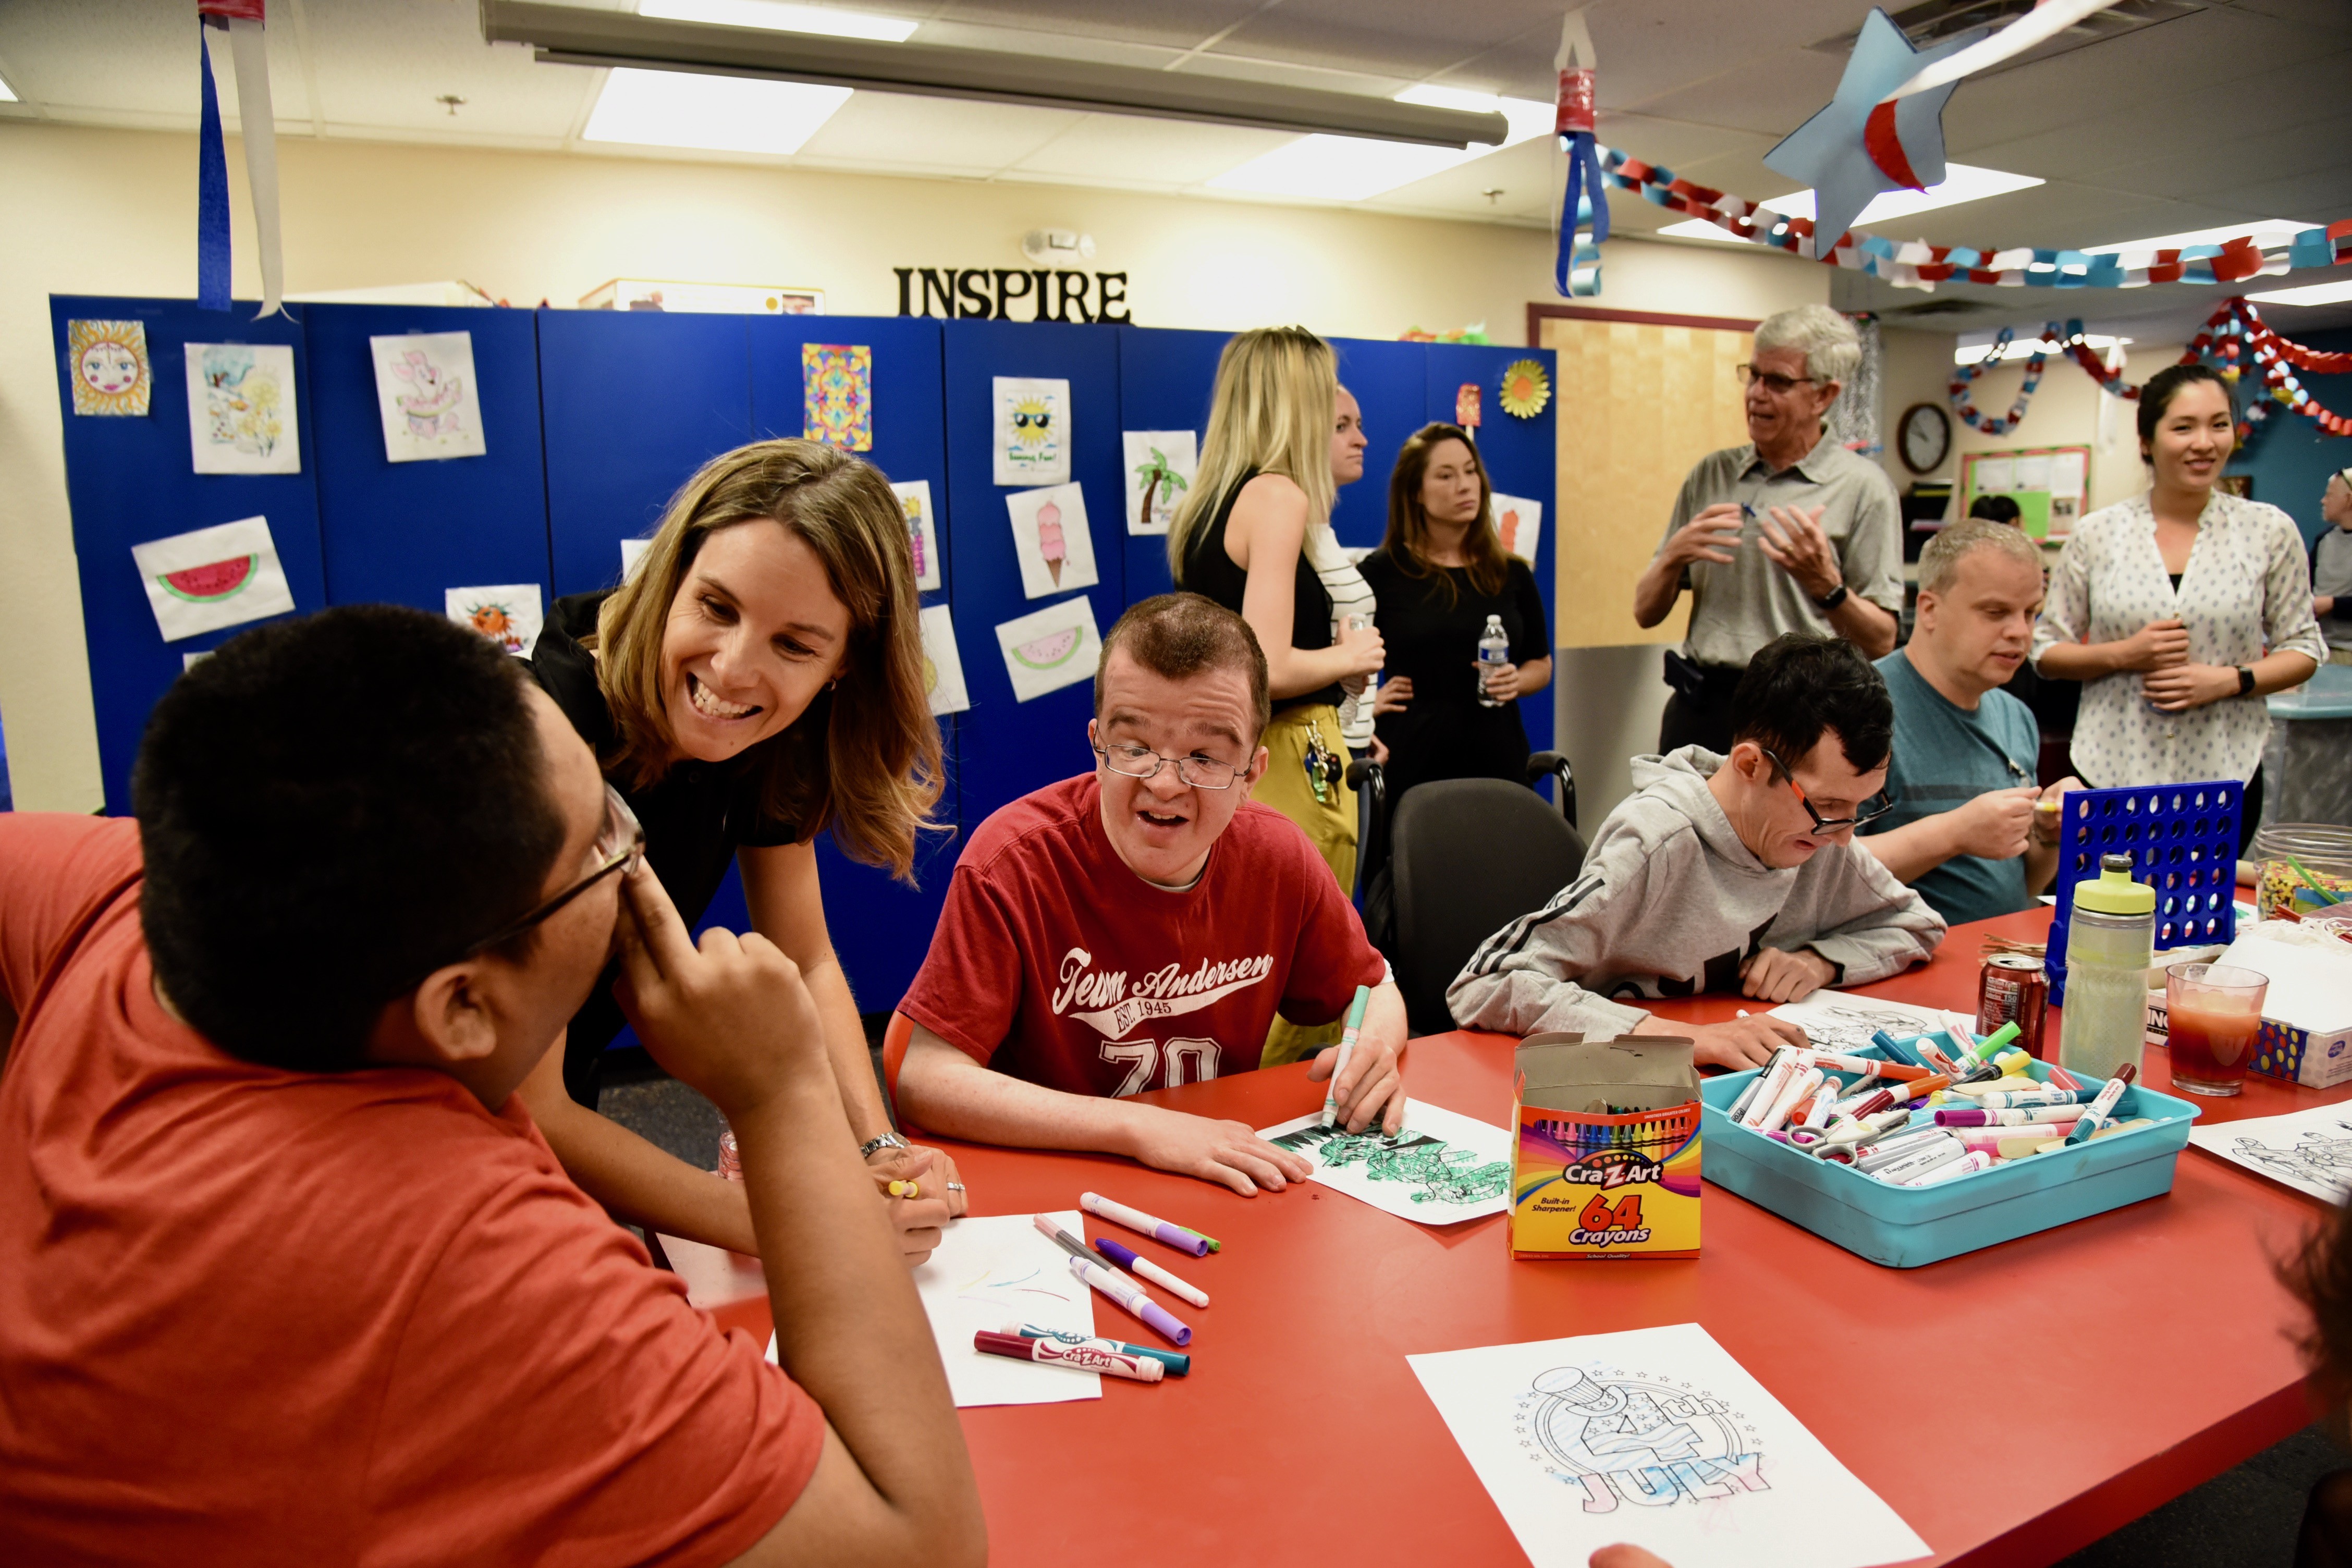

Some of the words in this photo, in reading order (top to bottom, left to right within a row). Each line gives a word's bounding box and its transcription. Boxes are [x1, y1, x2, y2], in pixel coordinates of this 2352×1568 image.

[893, 267, 1131, 324] INSPIRE
[1052, 947, 1127, 1014] Team
[1132, 953, 1273, 998] Andersen
[1114, 1001, 1135, 1033] EST.
[1138, 1001, 1172, 1016] 1945
[1099, 1037, 1222, 1098] 70
[1565, 1163, 1661, 1189] Cra-Z-Art
[1532, 1205, 1576, 1213] Sharpener!
[1579, 1193, 1643, 1231] 64
[1569, 1228, 1650, 1247] Crayons
[1578, 1453, 1771, 1513] JULY
